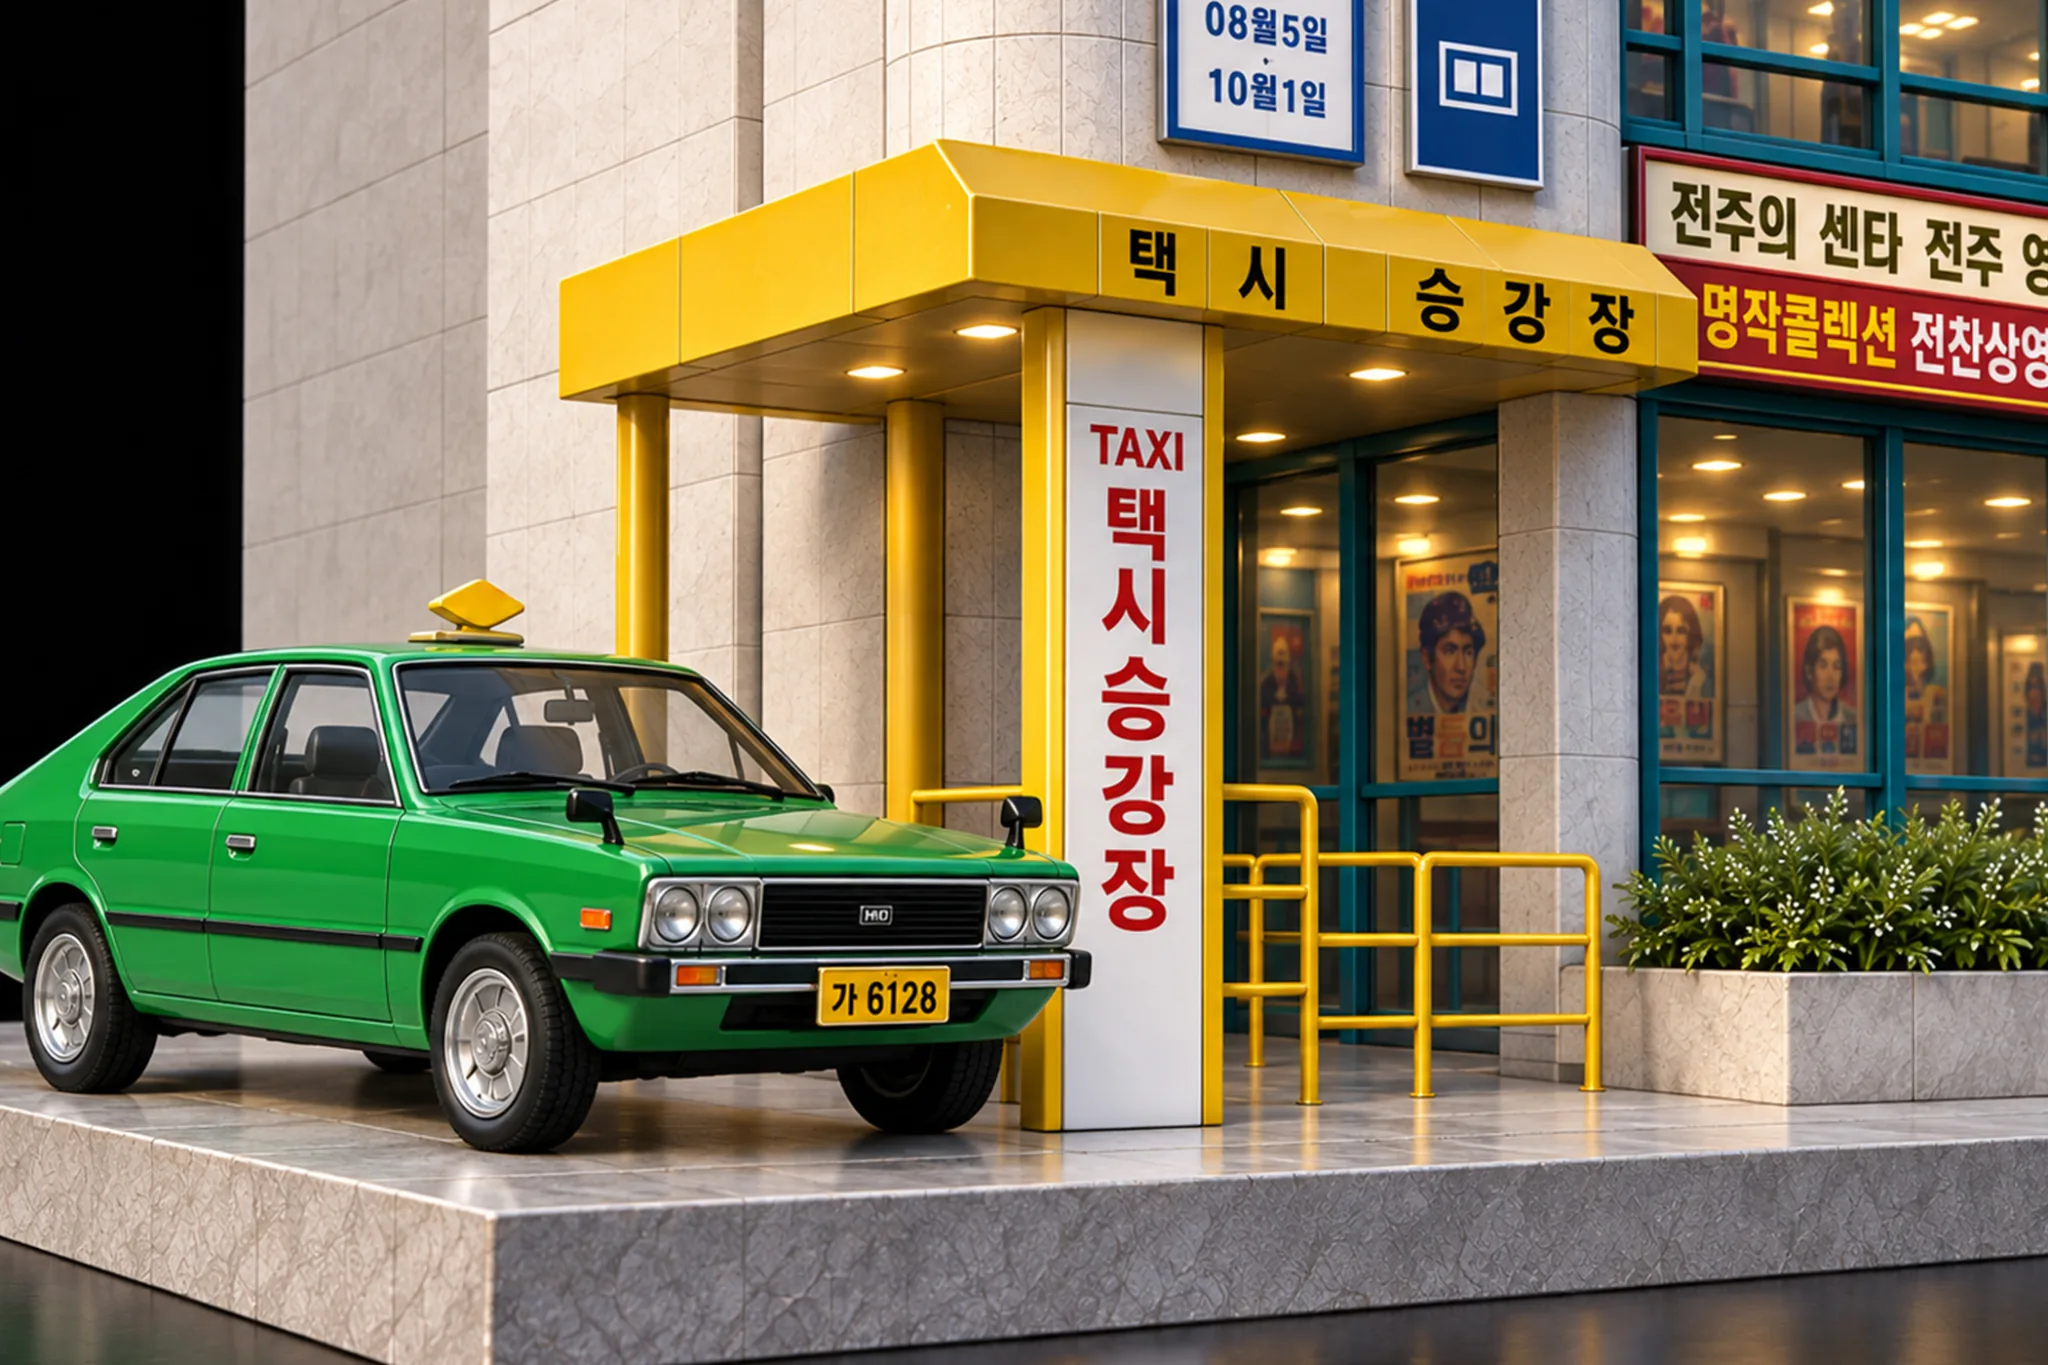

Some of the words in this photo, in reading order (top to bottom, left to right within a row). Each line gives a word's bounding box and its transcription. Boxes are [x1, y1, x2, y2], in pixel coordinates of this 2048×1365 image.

[1205, 1, 1327, 54] 08월5일
[1209, 68, 1326, 119] 10월1일
[1671, 181, 1796, 261] 전주의
[1819, 203, 1903, 275] 센타
[1925, 218, 2004, 288] 전주
[1703, 283, 1896, 369] 명작콜렉션
[1090, 424, 1184, 472] TAXI
[1101, 487, 1175, 932] 택시승강장
[832, 983, 858, 1016] 가
[867, 981, 937, 1016] 6128
